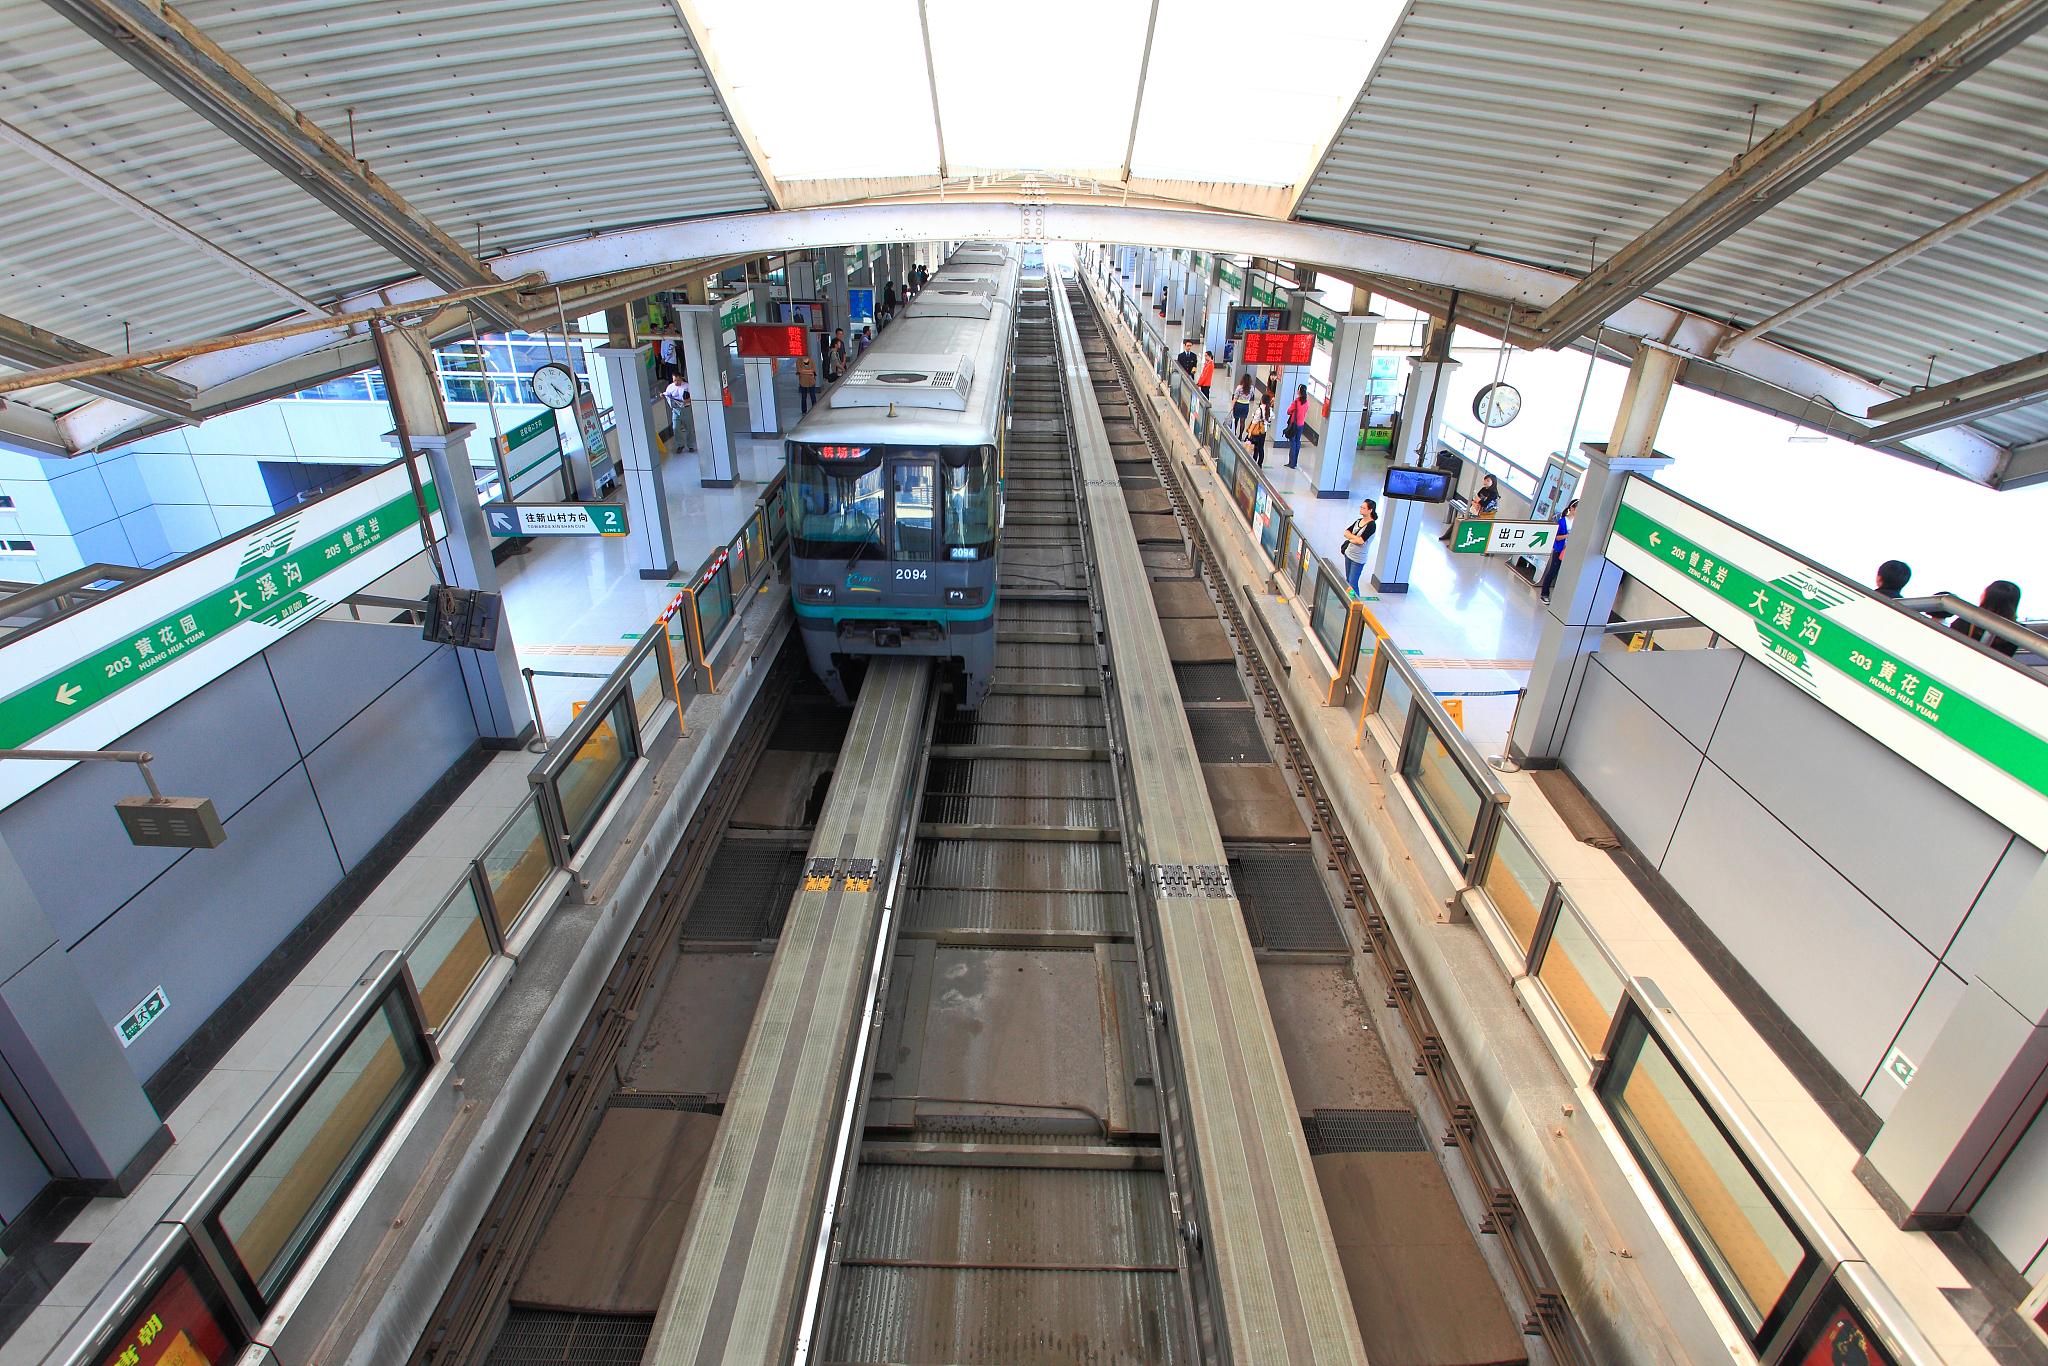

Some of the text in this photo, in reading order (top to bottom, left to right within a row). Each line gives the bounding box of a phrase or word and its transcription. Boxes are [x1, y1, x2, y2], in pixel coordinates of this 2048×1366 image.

[525, 512, 588, 523] 往新山村方向
[604, 511, 617, 525] 2
[324, 517, 380, 560] 205 曾家岩
[349, 533, 381, 555] ZENG JIA YAN
[1499, 527, 1525, 540] 出口
[261, 540, 276, 554] 204
[951, 548, 975, 558] 2094
[895, 568, 928, 581] 2094
[1671, 545, 1729, 584] 205 曾家岩
[229, 561, 303, 618] 大溪沟
[1687, 568, 1722, 591] ZENG JIA YAN
[1803, 581, 1819, 595] 204
[281, 608, 289, 618] DA
[293, 600, 303, 613] GOU
[1748, 589, 1823, 646] 大溪沟
[104, 614, 199, 679] 203 黄花园
[138, 629, 206, 672] HUANG HUA YUAN
[1786, 650, 1798, 664] GOU
[1848, 650, 1945, 710] 203 黄花园
[1868, 675, 1940, 723] HUANG HUA YUAN
